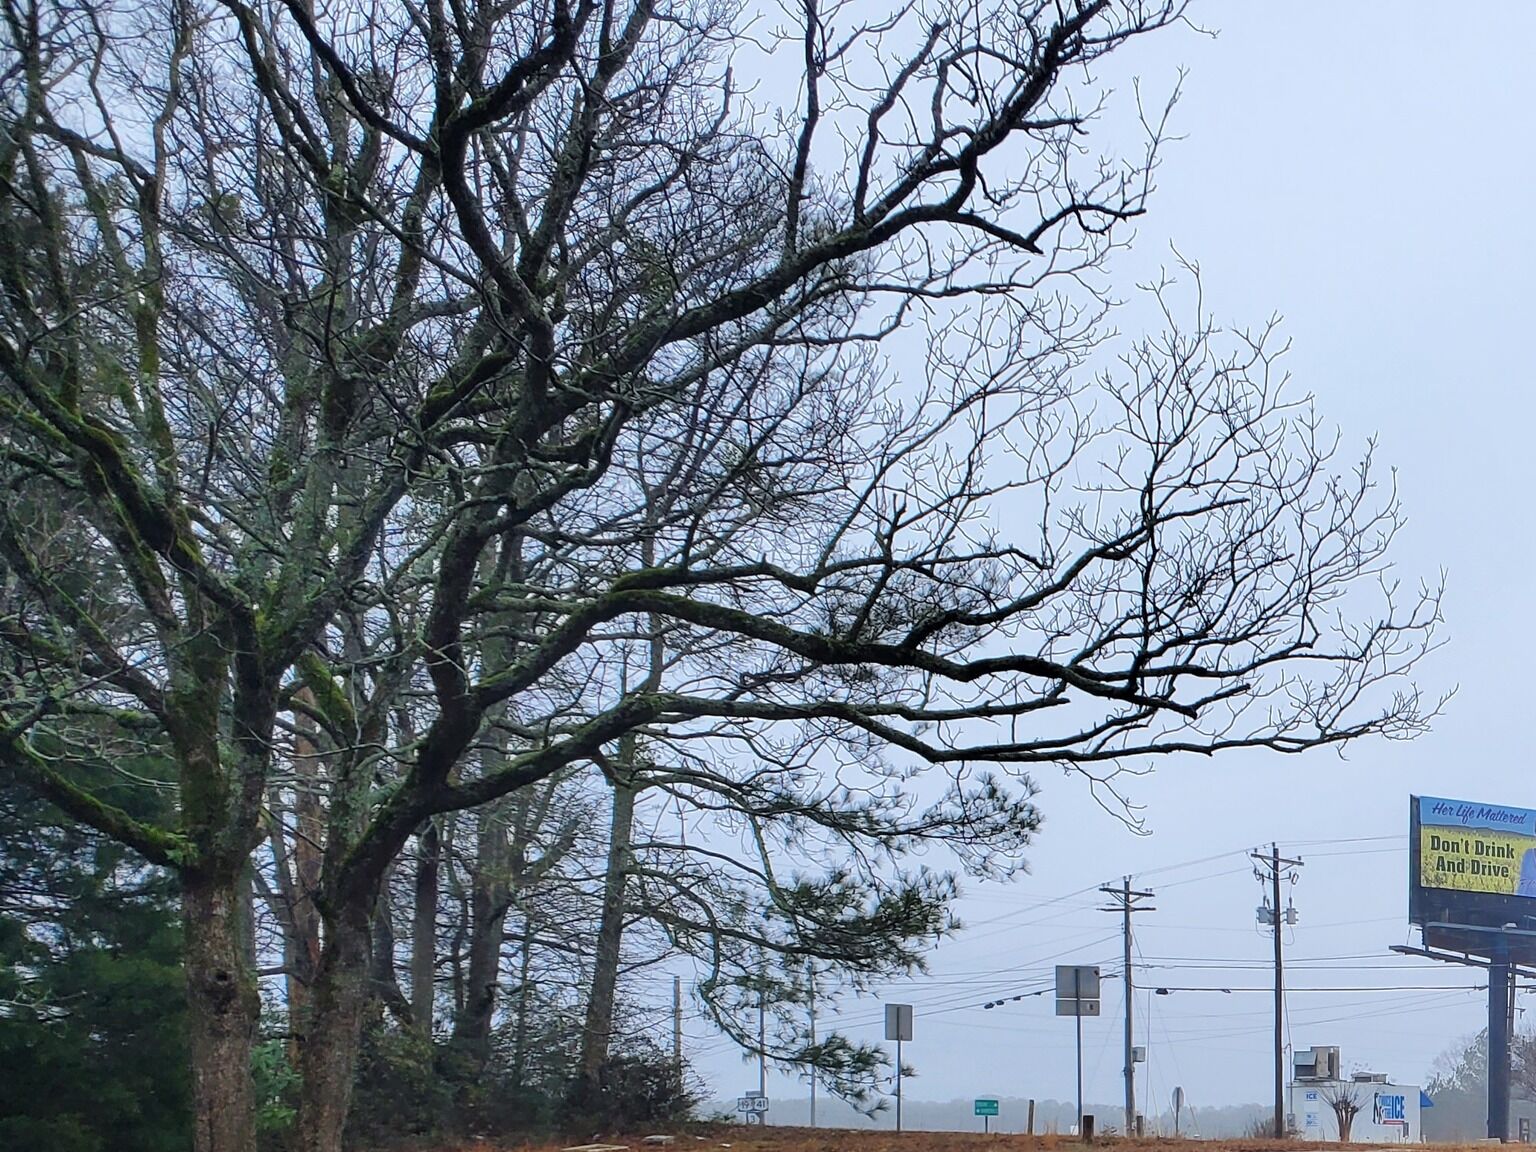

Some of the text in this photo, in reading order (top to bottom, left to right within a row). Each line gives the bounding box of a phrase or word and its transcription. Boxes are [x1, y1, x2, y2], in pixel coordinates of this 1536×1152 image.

[1432, 803, 1527, 824] Her Life Mattered
[1430, 835, 1515, 859] Don't Drink
[1436, 855, 1509, 878] And Drive
[1391, 1095, 1405, 1120] ICE
